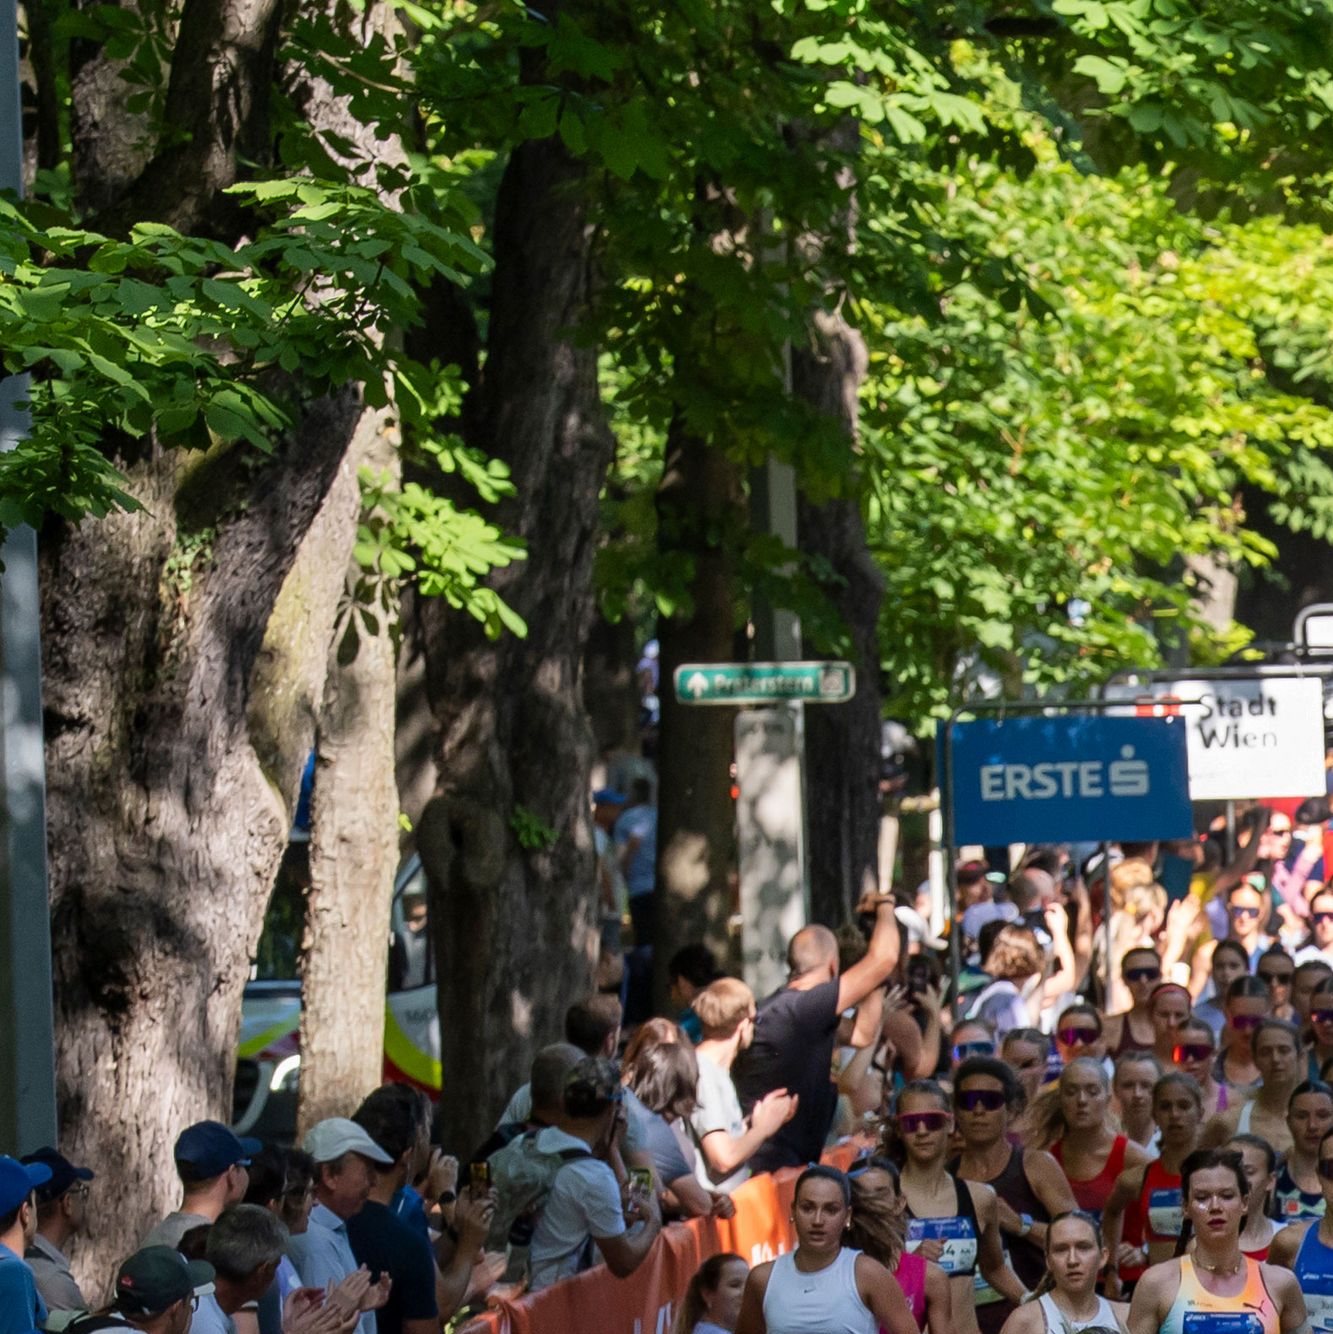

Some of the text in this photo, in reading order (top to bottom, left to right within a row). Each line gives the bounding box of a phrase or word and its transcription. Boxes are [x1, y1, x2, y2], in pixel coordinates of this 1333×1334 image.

[1200, 694, 1278, 721] Stadt
[1199, 724, 1278, 750] Wien
[980, 761, 1104, 801] ERSTE
